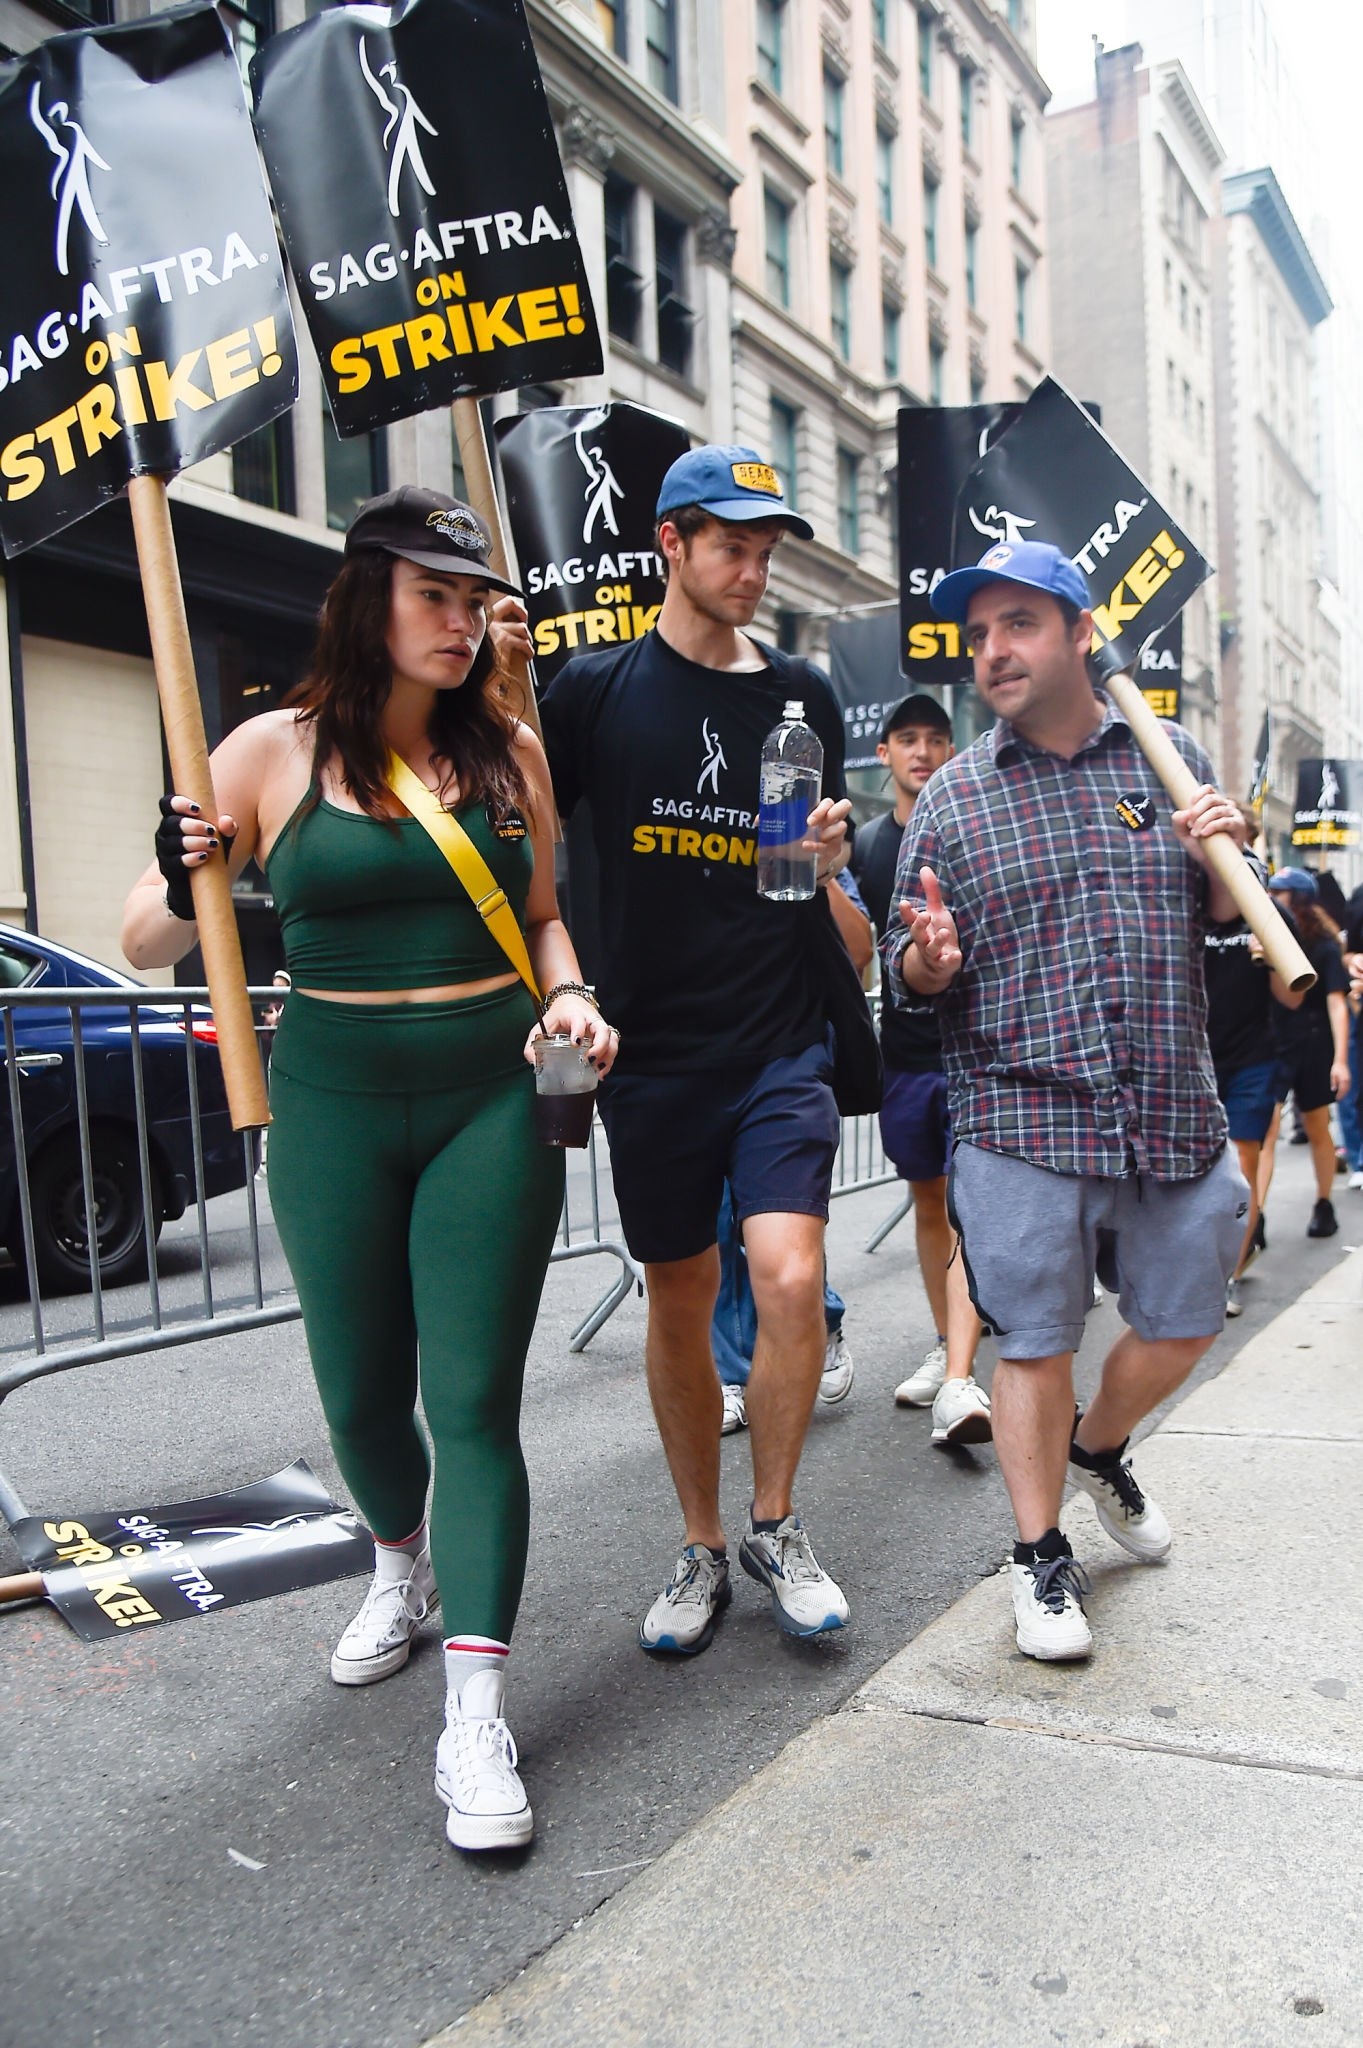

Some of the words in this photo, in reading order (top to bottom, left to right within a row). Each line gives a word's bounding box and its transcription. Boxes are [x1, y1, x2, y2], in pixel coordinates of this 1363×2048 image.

[416, 270, 467, 307] ON
[85, 326, 142, 376] ON
[330, 283, 586, 394] STRIKE!
[0, 315, 283, 502] STRIKE!
[595, 584, 632, 605] ON
[632, 824, 759, 867] STRON
[43, 1520, 164, 1628] STRIKE!
[119, 1543, 153, 1572] ON
